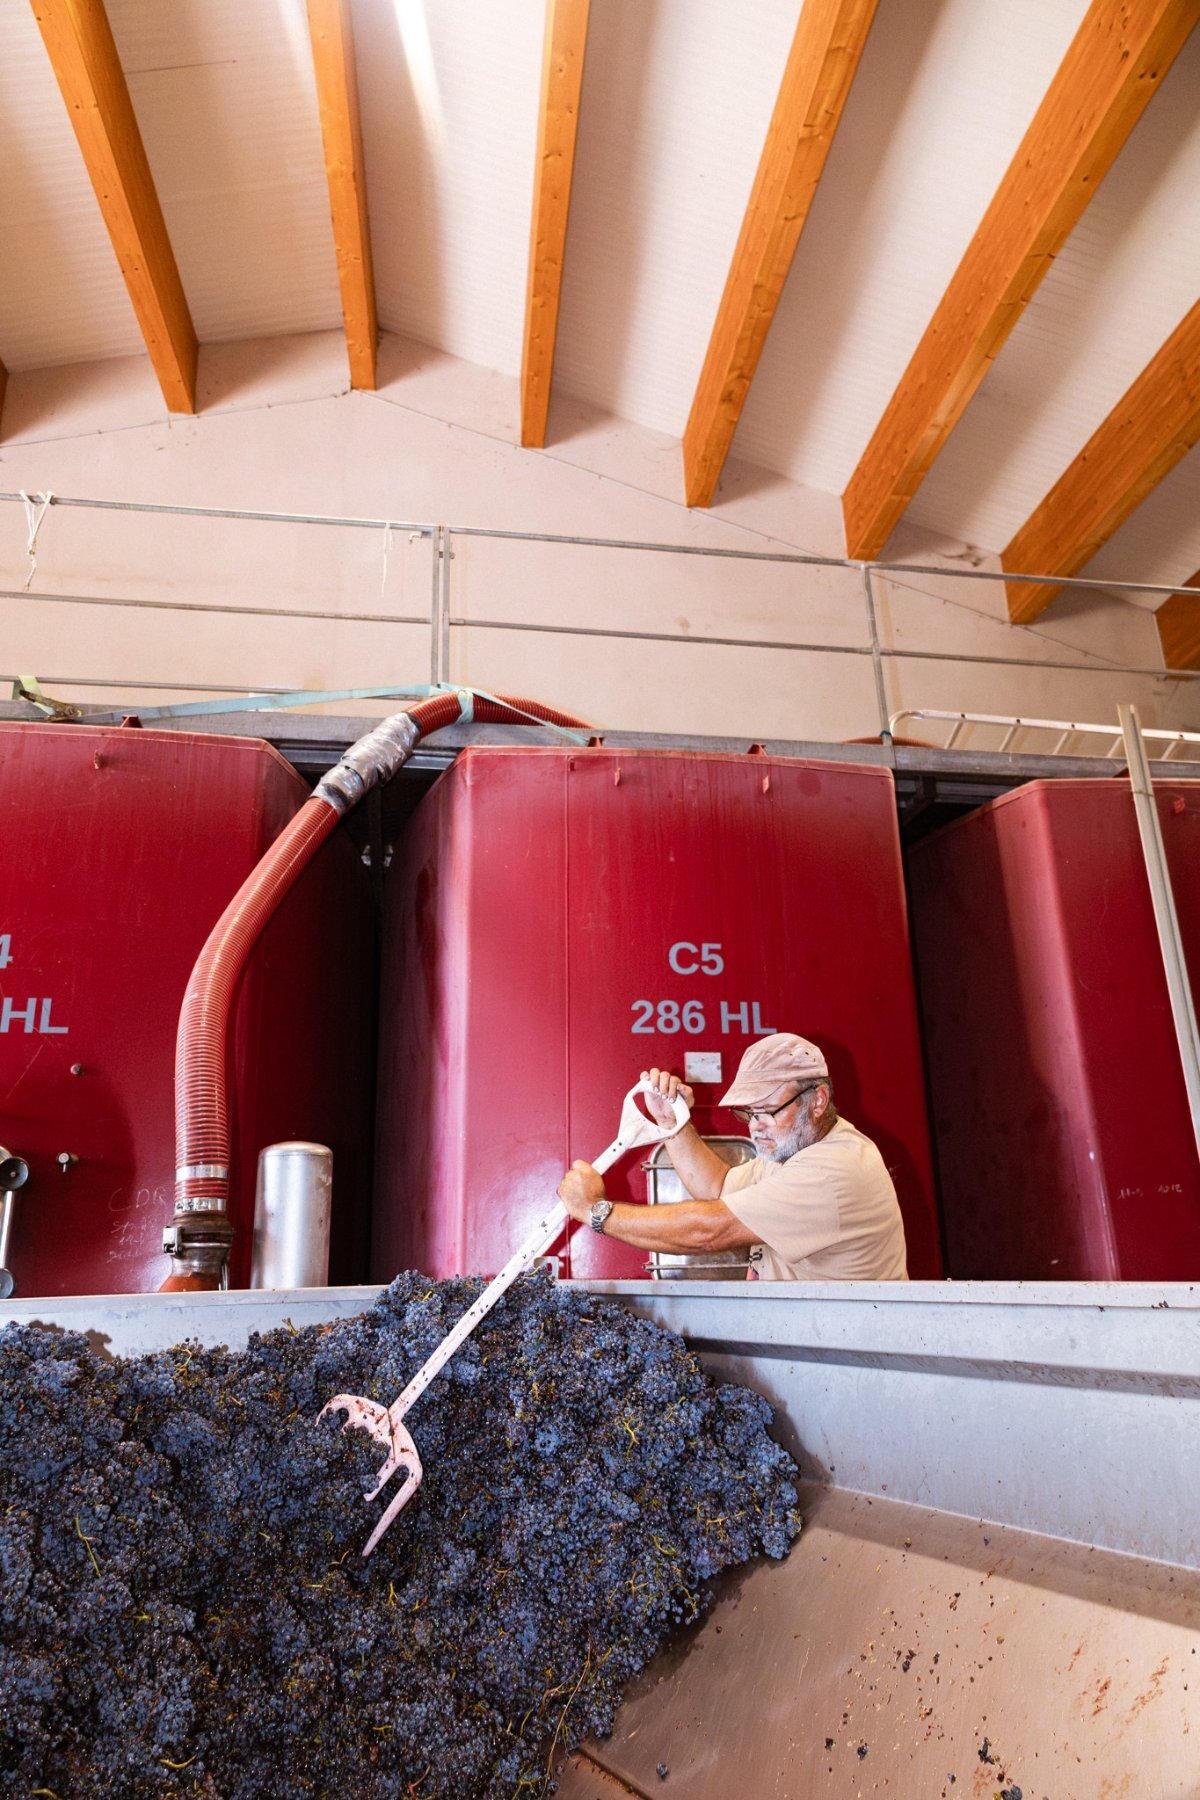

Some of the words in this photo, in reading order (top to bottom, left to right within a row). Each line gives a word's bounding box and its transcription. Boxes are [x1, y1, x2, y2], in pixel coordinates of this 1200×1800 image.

[668, 941, 724, 976] C5
[0, 997, 69, 1034] HL
[630, 999, 706, 1034] 286
[720, 1001, 778, 1034] HL
